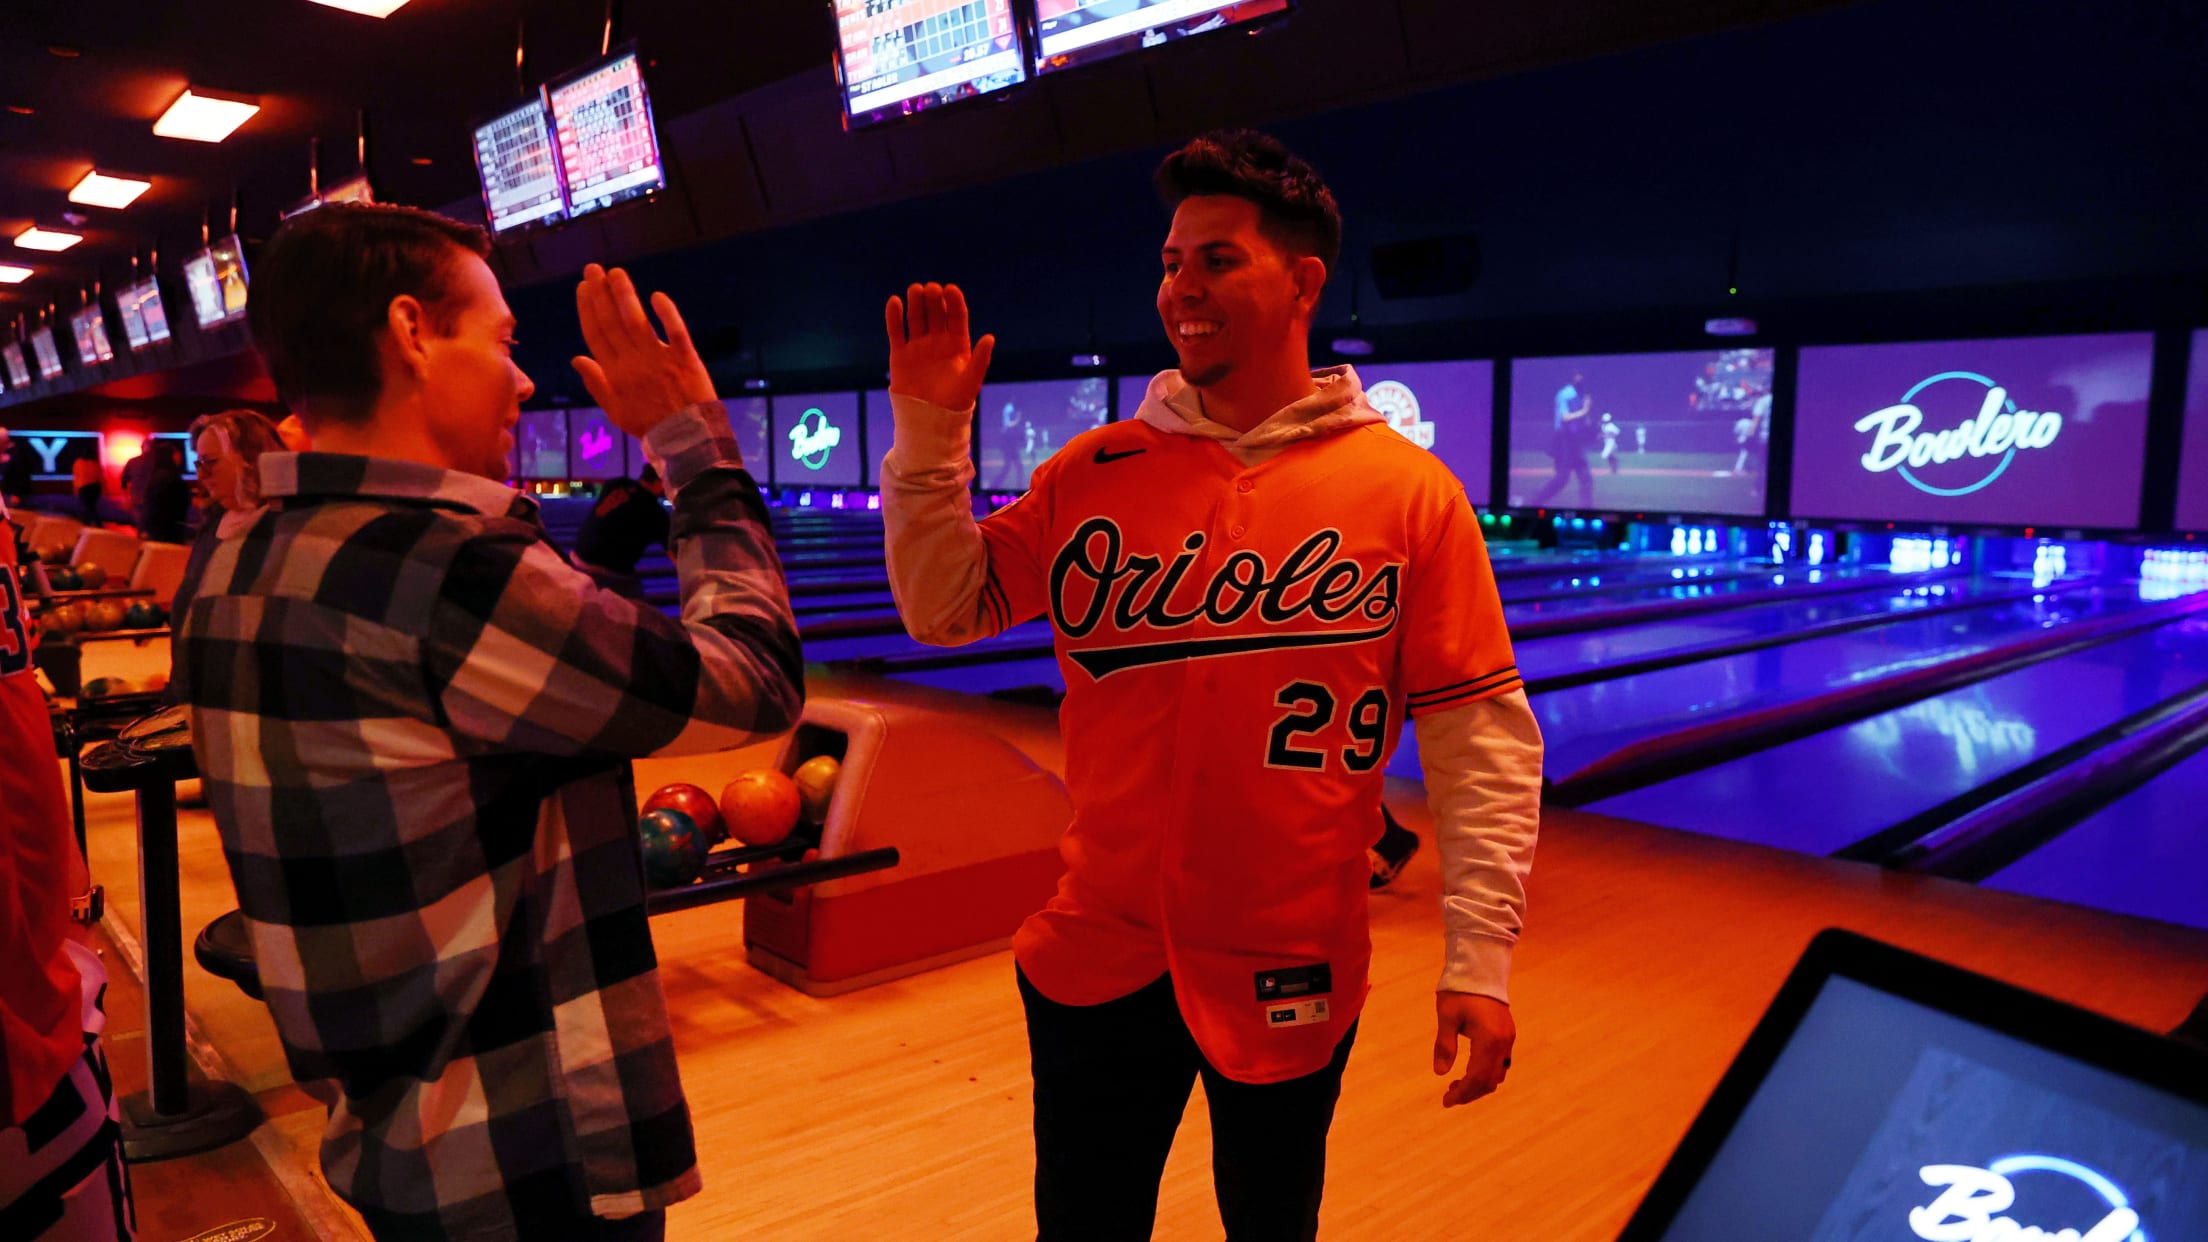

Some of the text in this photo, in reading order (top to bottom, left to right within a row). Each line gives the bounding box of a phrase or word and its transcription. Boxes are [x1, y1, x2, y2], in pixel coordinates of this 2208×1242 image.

[28, 438, 68, 473] Y
[1854, 386, 2062, 472] Bowlero
[1049, 515, 1401, 638] Orioles
[1264, 679, 1389, 774] 29
